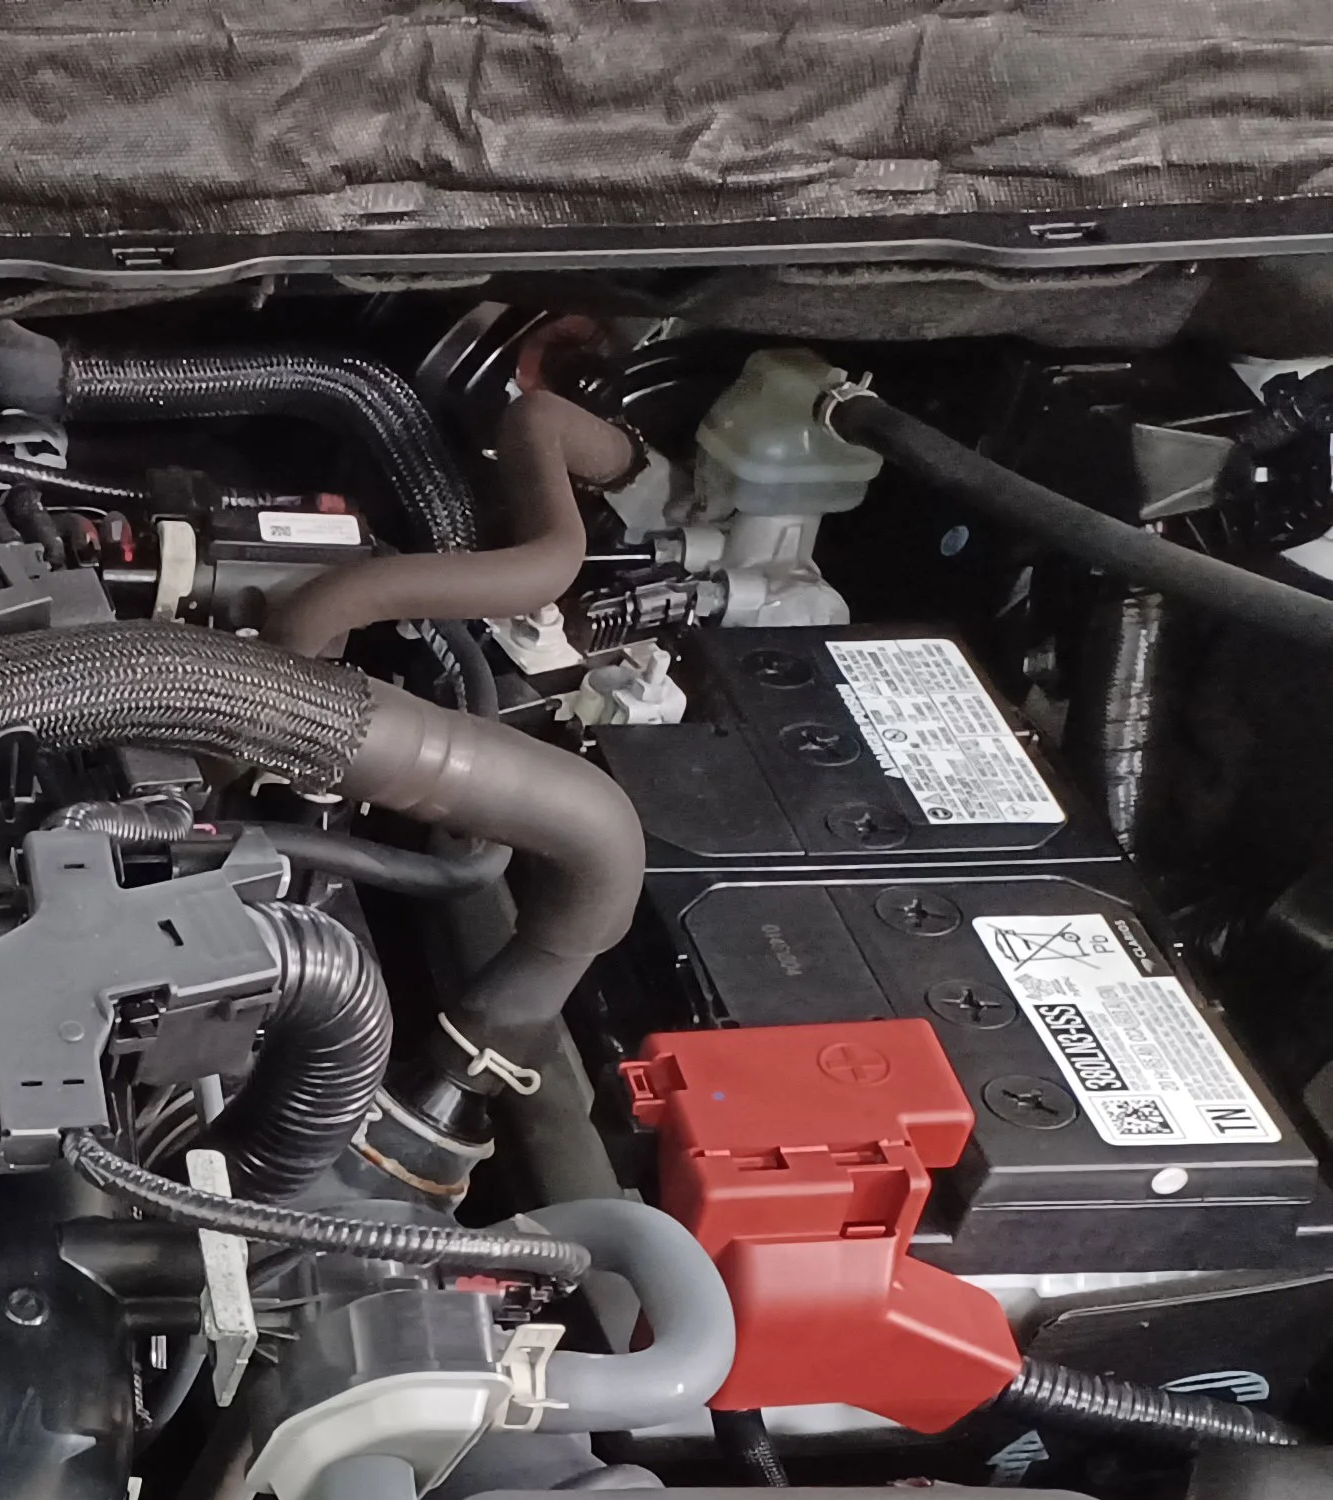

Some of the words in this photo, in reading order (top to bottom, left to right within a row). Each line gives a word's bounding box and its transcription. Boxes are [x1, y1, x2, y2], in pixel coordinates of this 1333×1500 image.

[1089, 934, 1115, 954] Pb
[1114, 919, 1147, 959] CLARIOS
[1038, 1004, 1123, 1091] 380LN3-ISS
[1205, 1108, 1258, 1134] TN
